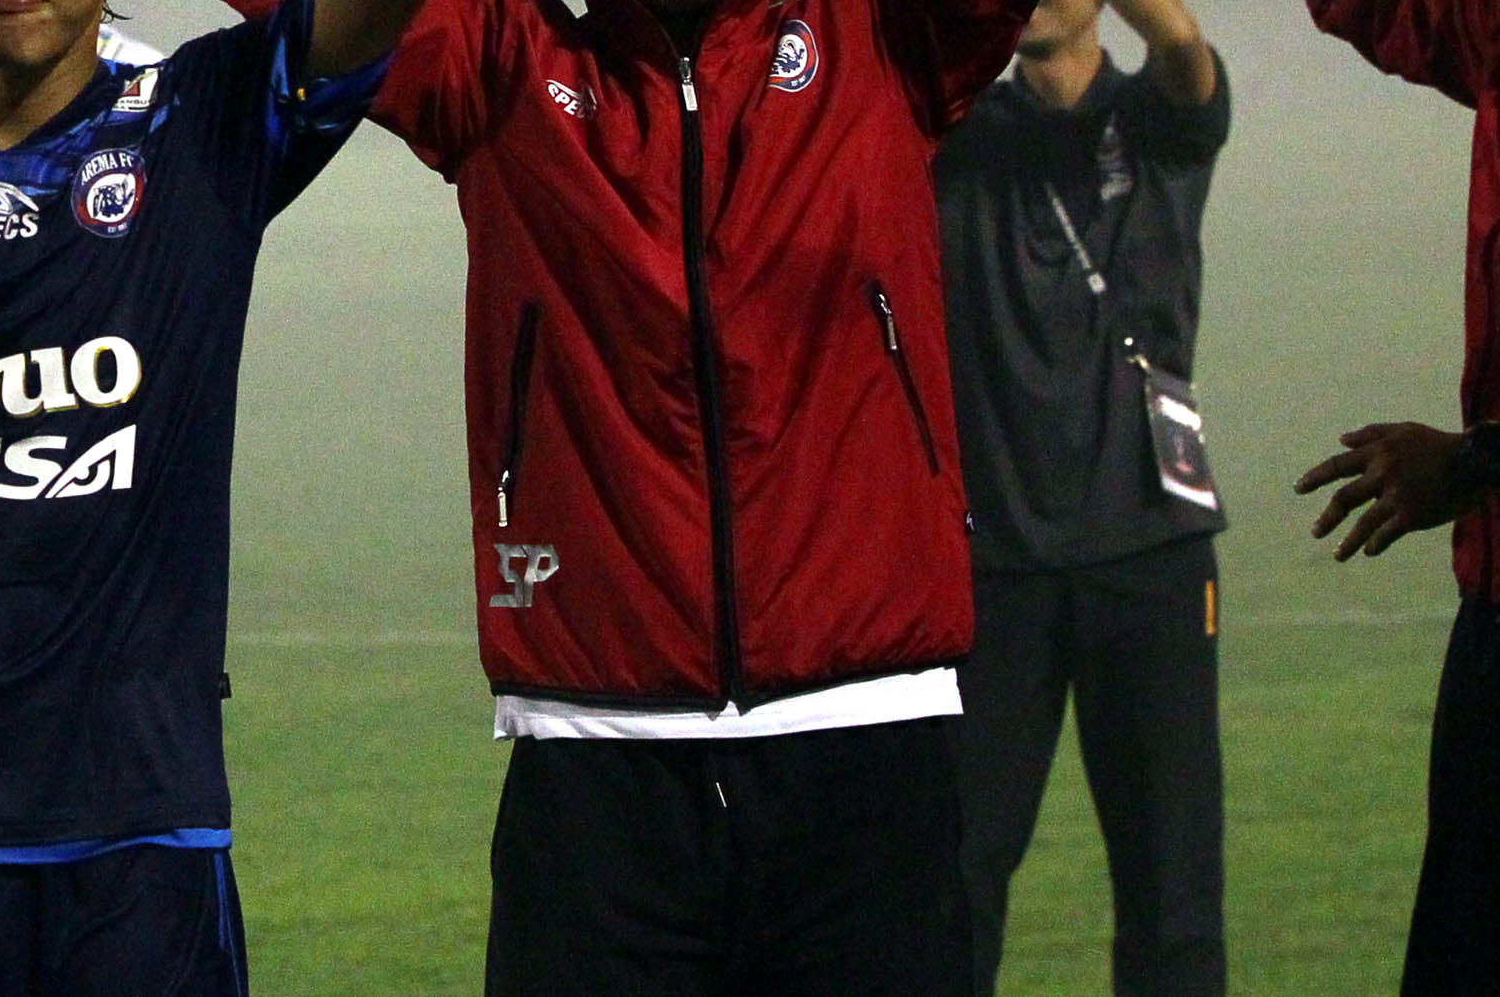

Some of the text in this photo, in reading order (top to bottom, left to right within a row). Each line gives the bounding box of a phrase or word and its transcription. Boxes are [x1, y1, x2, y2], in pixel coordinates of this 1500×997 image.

[548, 84, 591, 118] SPE
[81, 152, 134, 186] AREMA FC
